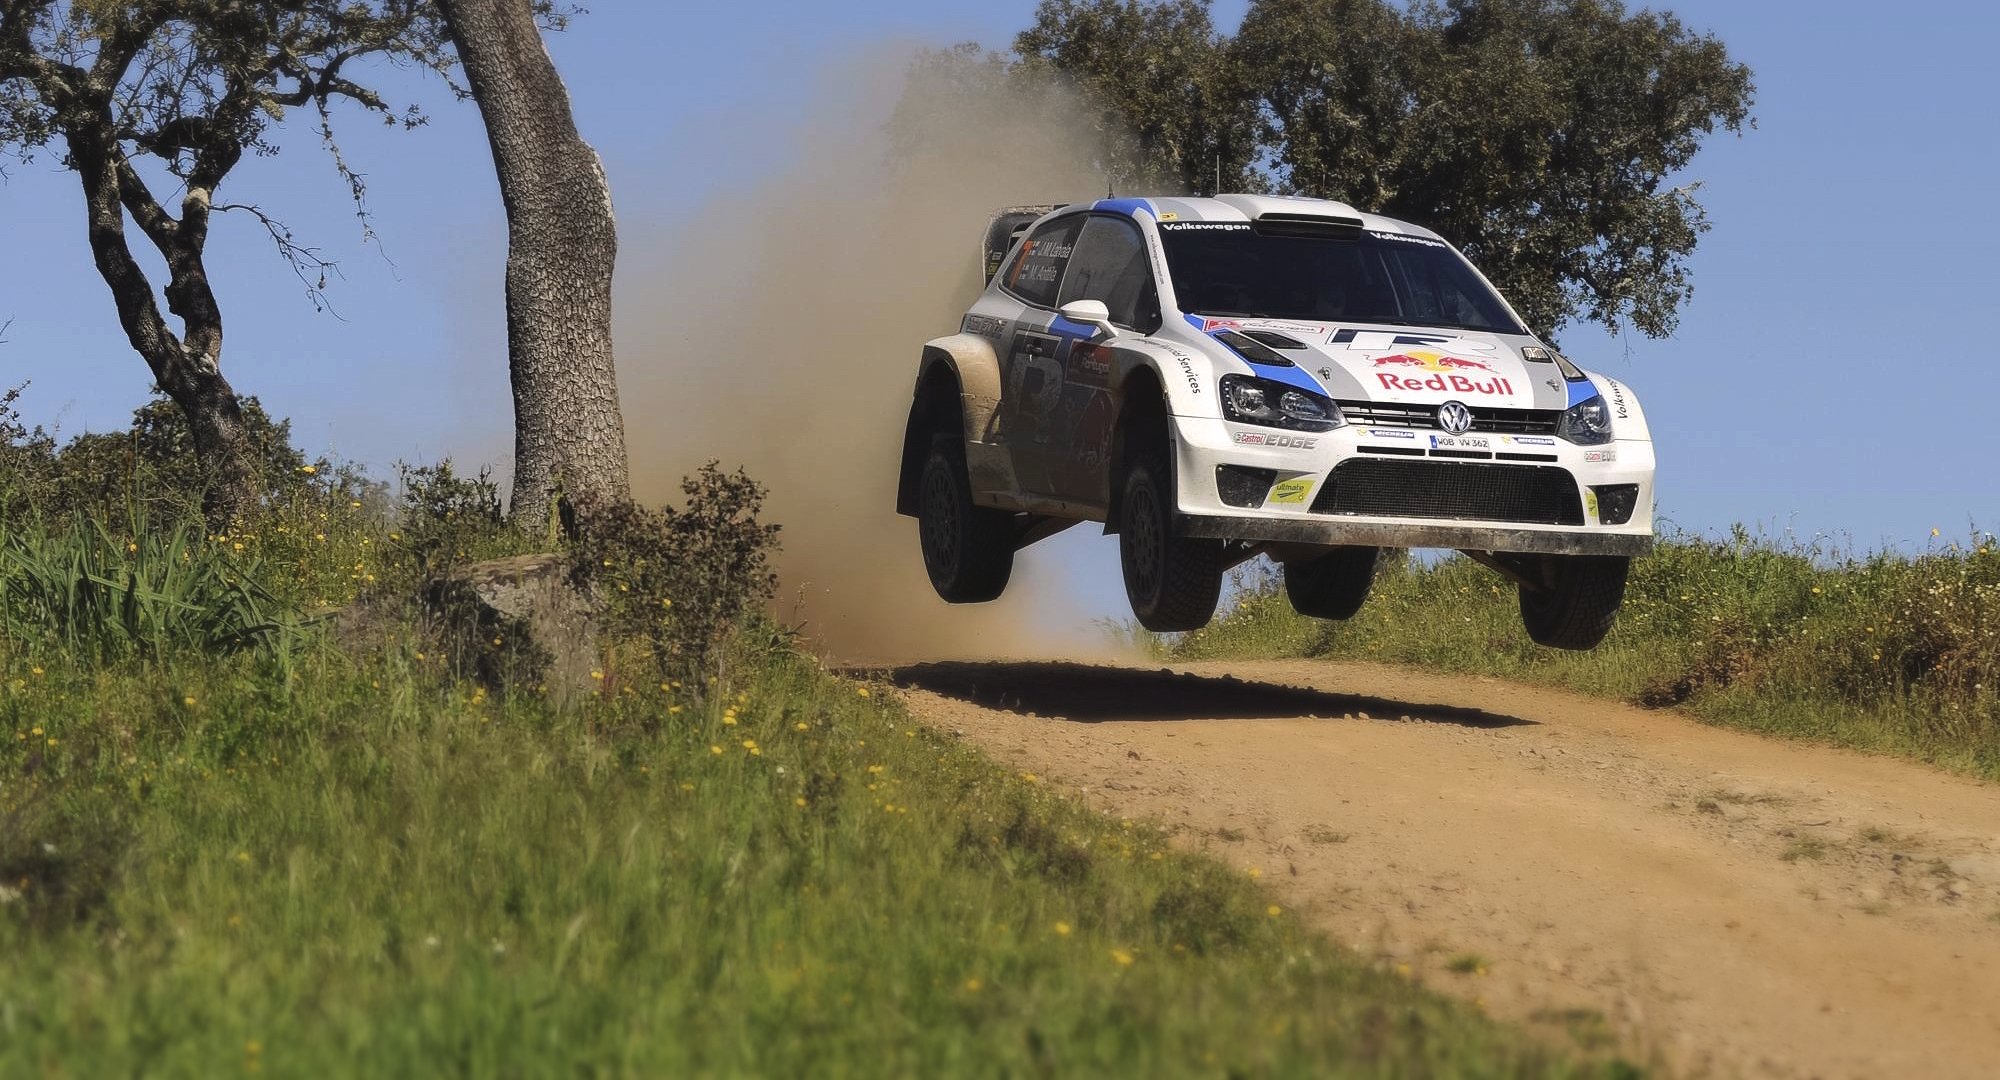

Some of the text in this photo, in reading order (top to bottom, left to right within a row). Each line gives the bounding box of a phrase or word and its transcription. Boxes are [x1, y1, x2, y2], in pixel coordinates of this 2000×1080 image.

[1162, 222, 1251, 231] Volkswagen
[1369, 231, 1446, 248] Volkswagen
[1177, 357, 1201, 394] Services
[1376, 373, 1514, 396] Red Bull
[1265, 434, 1319, 450] EDGE
[1374, 430, 1414, 438] MICHELIN
[1437, 438, 1455, 446] WOB
[1472, 440, 1489, 448] 362
